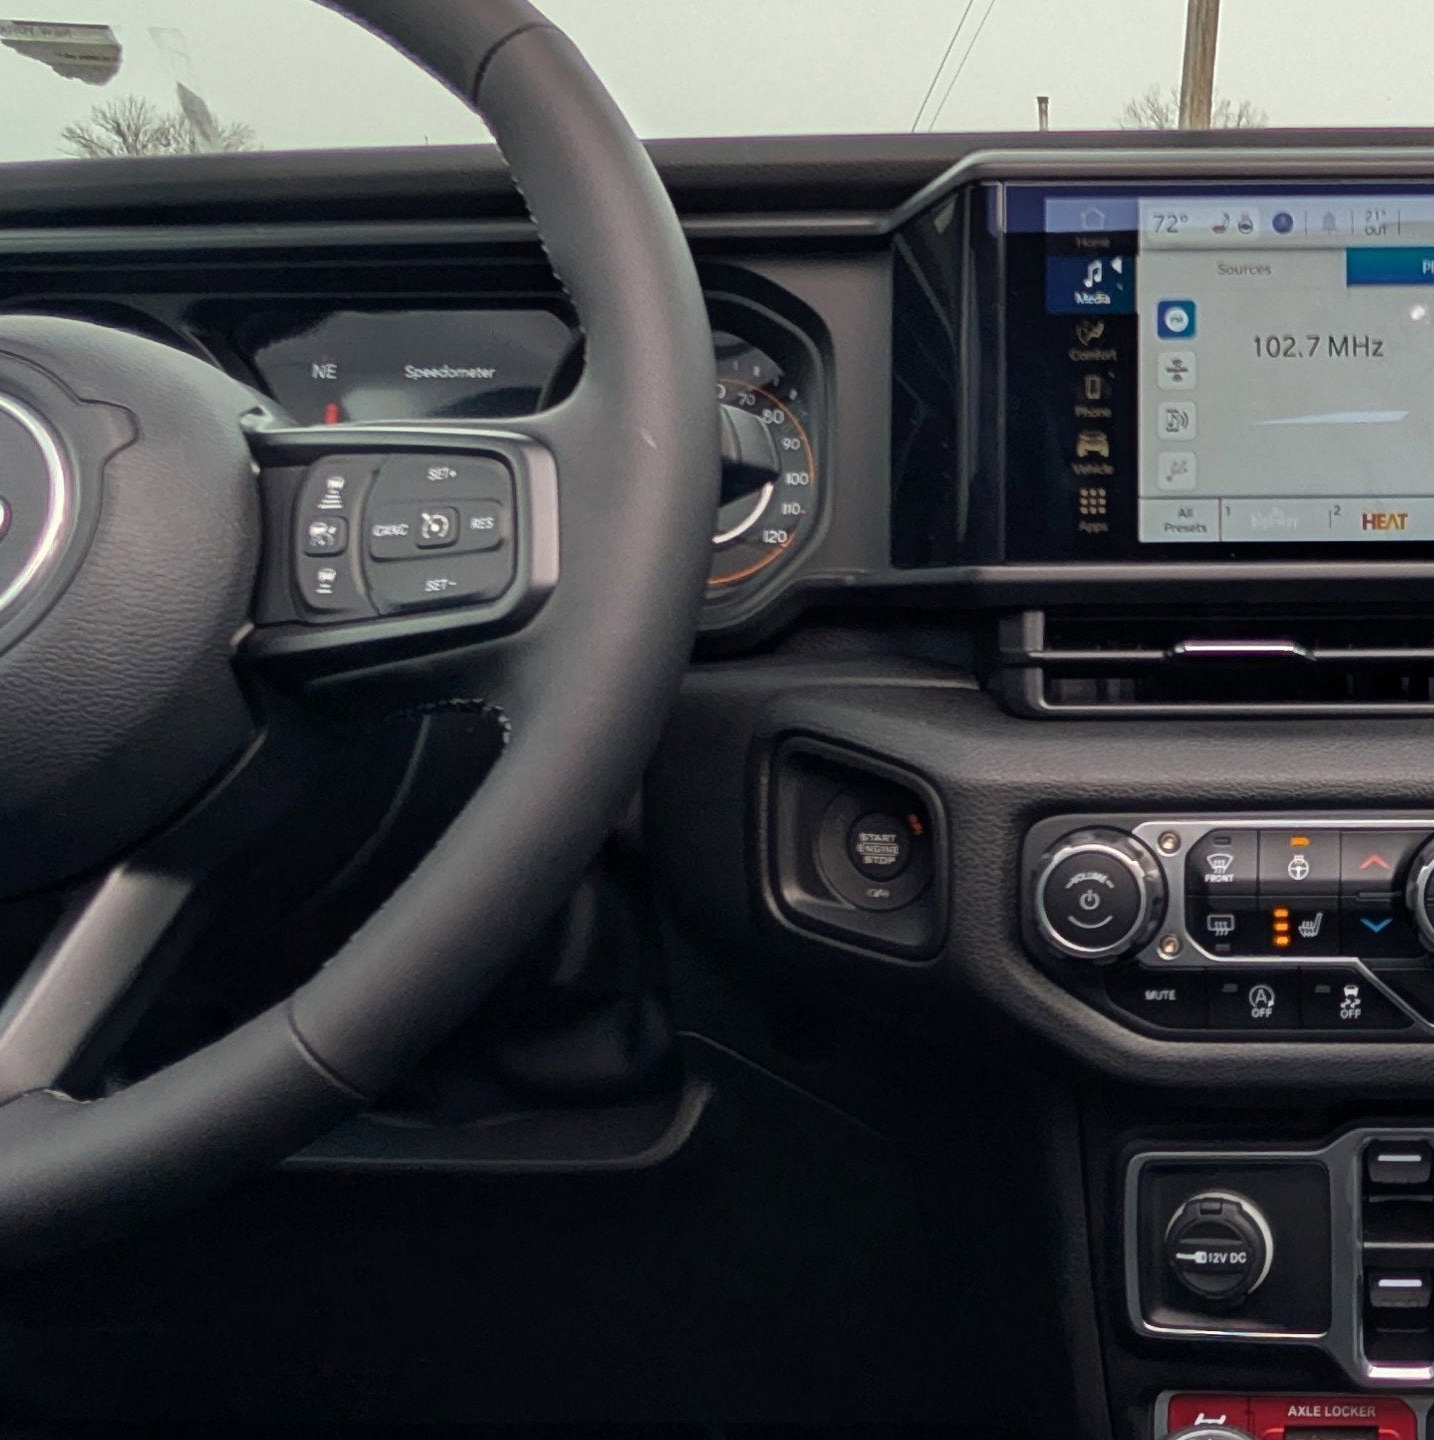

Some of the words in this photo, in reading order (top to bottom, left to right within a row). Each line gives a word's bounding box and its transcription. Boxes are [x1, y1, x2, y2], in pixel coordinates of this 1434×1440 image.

[1153, 214, 1188, 234] 72°
[1365, 224, 1387, 236] OUT
[1218, 263, 1272, 276] Sources
[1074, 290, 1111, 305] Media
[1254, 335, 1321, 358] 102.7
[1327, 334, 1384, 358] MHz
[311, 363, 338, 380] NE
[404, 364, 497, 380] Speedometer
[738, 392, 756, 406] 70
[762, 409, 785, 425] 80
[782, 437, 801, 450] 90
[785, 472, 810, 486] 100
[1362, 513, 1408, 531] HEAT
[763, 530, 788, 544] 120
[1204, 873, 1234, 883] FRONT
[1145, 990, 1176, 1001] MUTE
[1251, 1007, 1273, 1019] OFF
[1340, 1007, 1362, 1020] OFF
[1229, 1251, 1247, 1264] DC
[1287, 1405, 1321, 1417] AXLE
[1324, 1405, 1376, 1417] LOCKER
